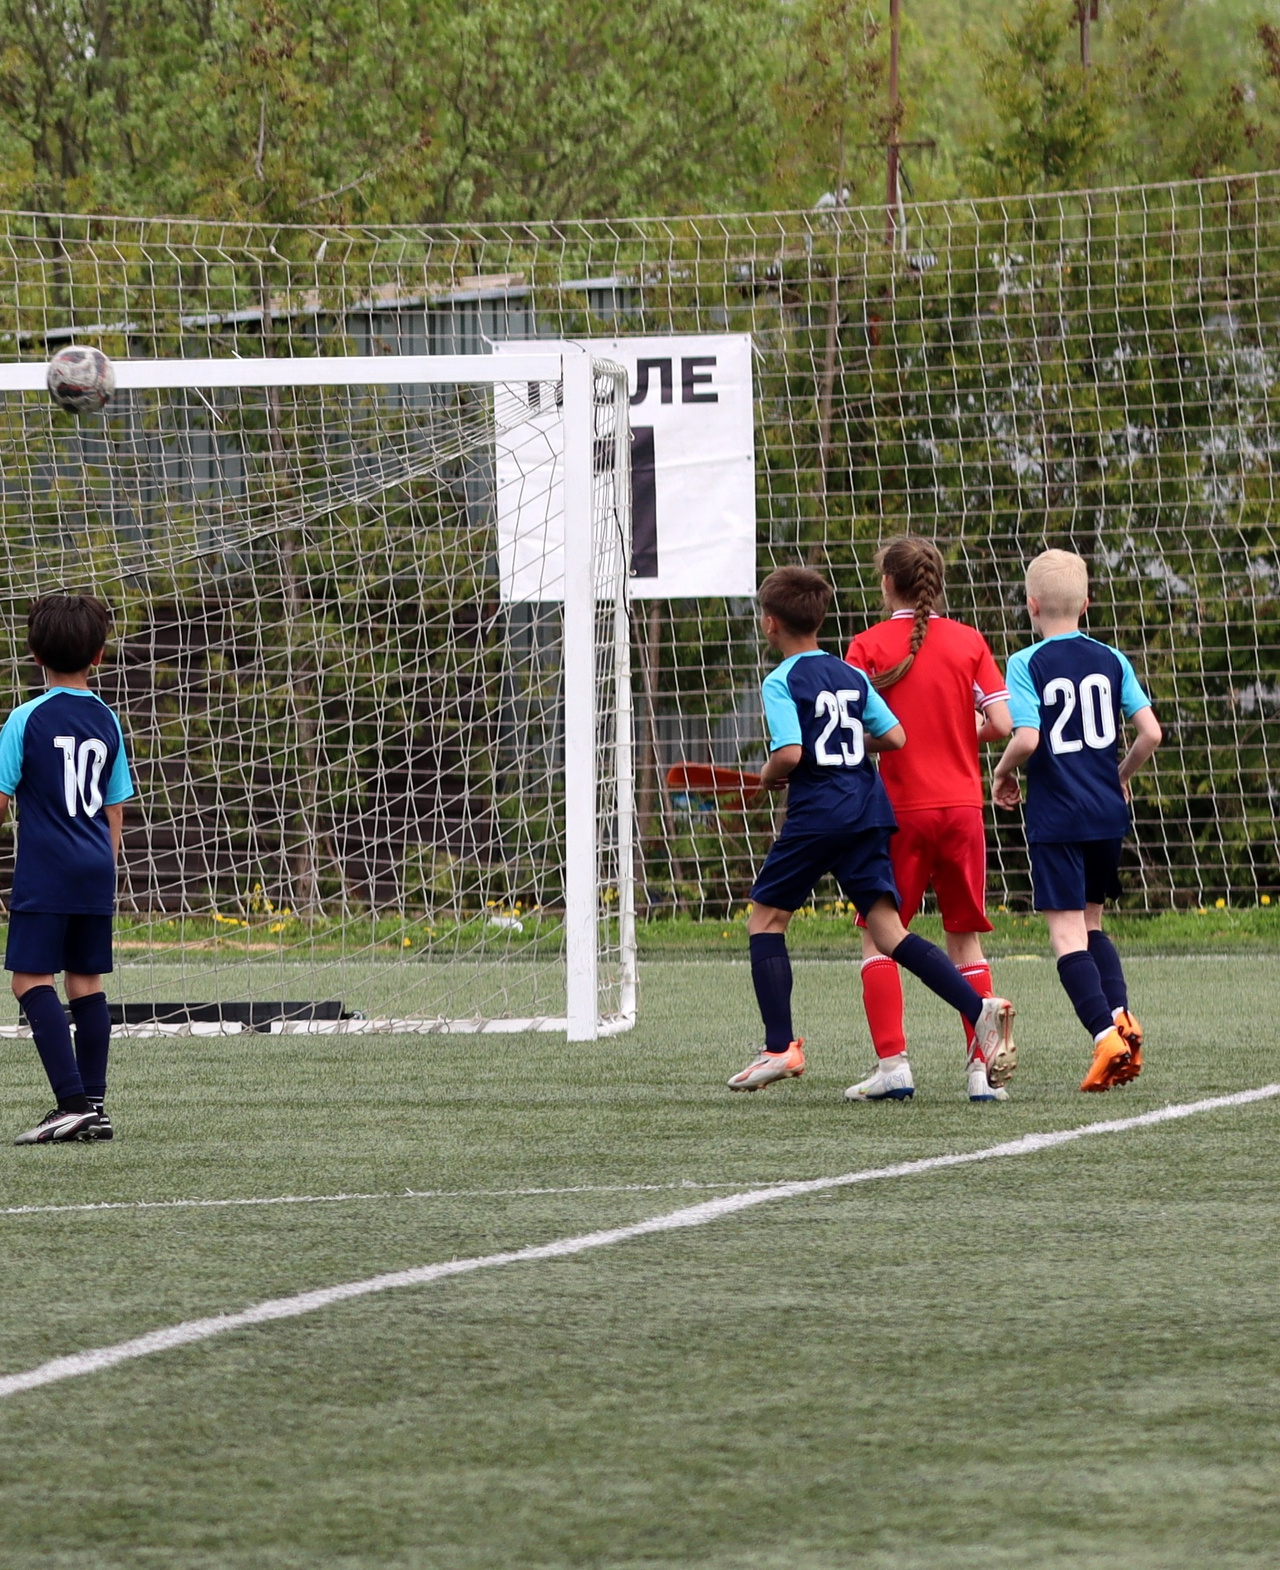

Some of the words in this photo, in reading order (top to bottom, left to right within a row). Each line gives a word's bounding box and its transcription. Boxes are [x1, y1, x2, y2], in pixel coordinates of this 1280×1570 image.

[593, 426, 658, 578] 1
[814, 689, 865, 766] 25
[1043, 673, 1116, 755] 20
[53, 735, 108, 818] 10
